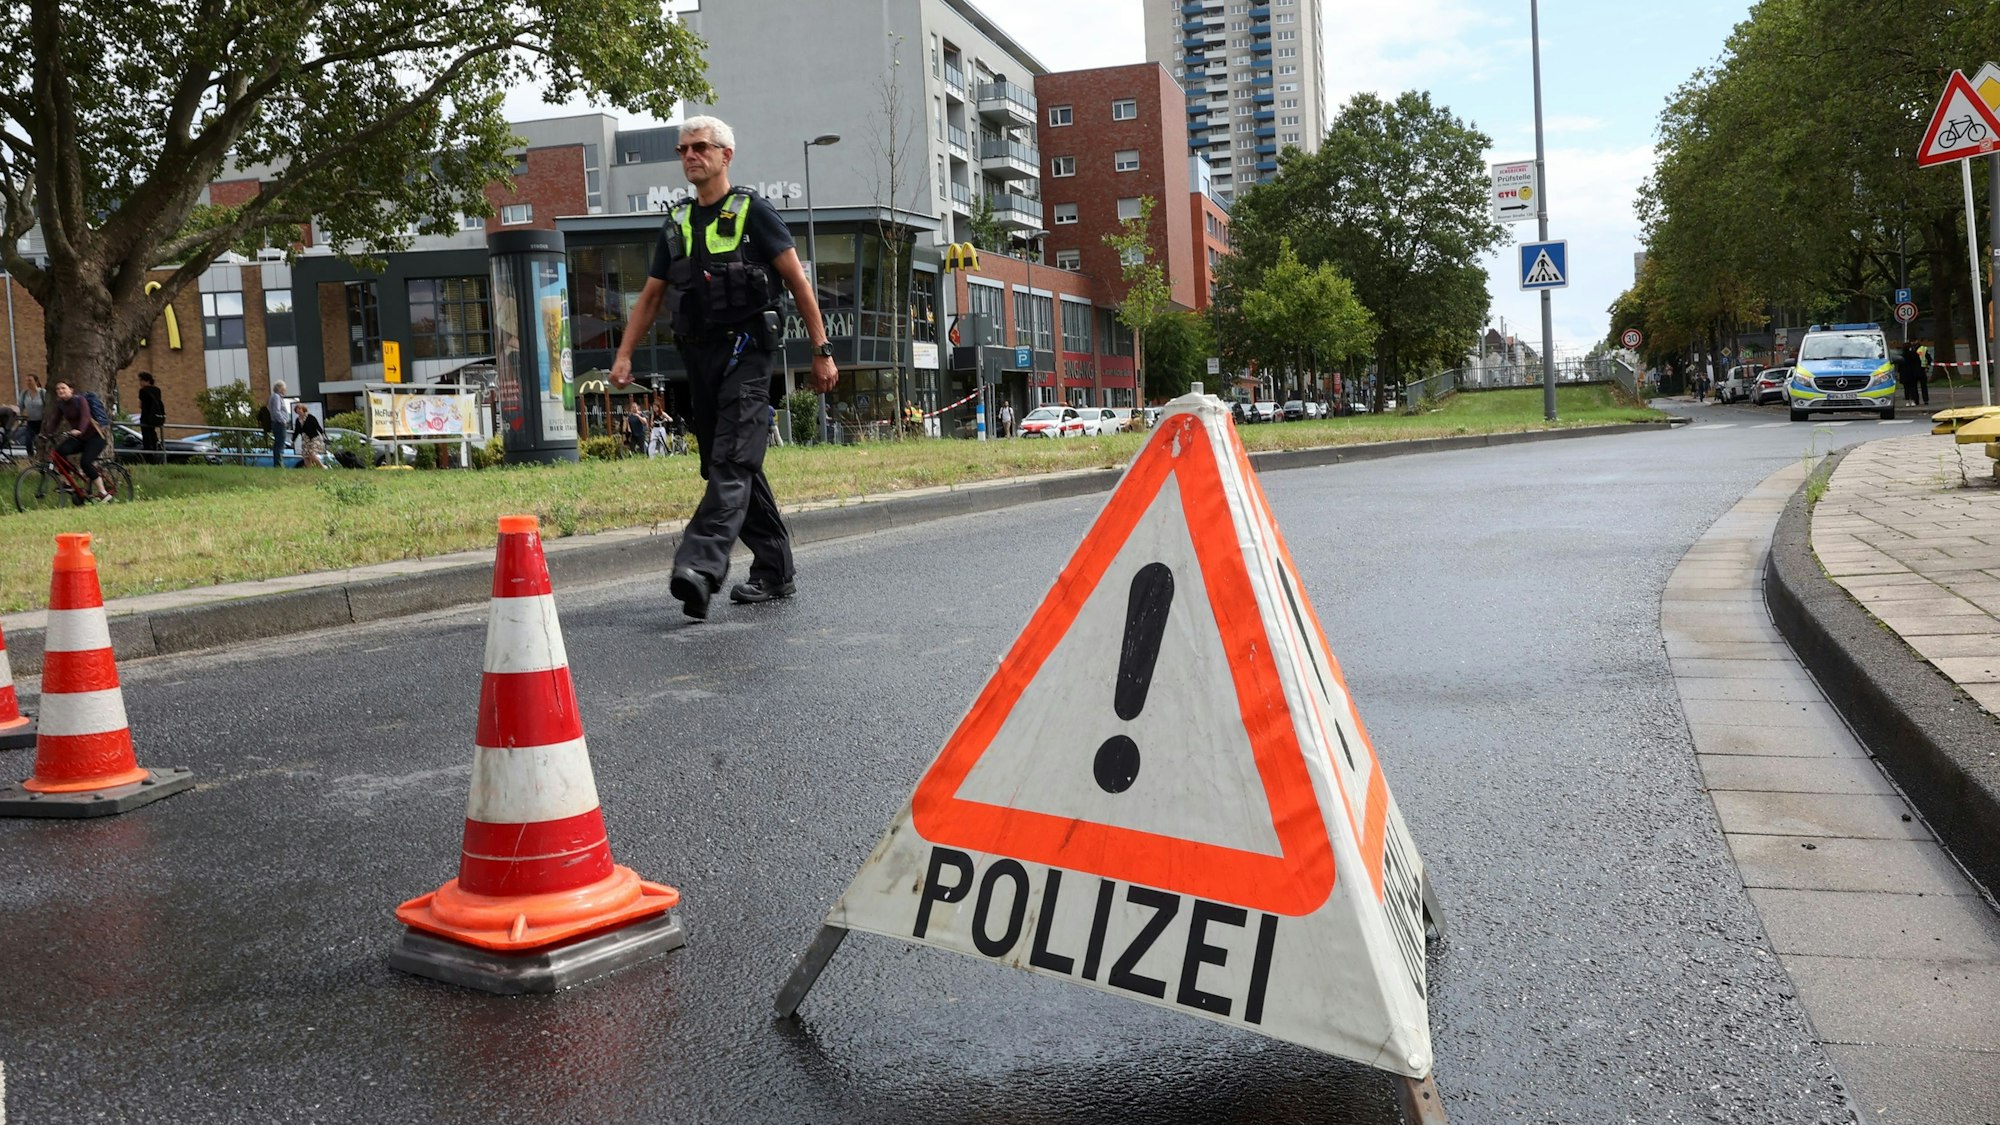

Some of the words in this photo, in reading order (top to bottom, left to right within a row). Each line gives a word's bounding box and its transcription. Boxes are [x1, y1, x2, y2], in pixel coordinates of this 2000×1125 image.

[1497, 174, 1531, 182] Prüfstelle
[1498, 190, 1517, 198] GTÜ
[1899, 291, 1907, 301] P
[1900, 308, 1912, 316] 30
[1626, 334, 1638, 343] 30
[384, 346, 390, 354] U
[1019, 354, 1028, 364] P
[913, 846, 1278, 1025] POLIZEI
